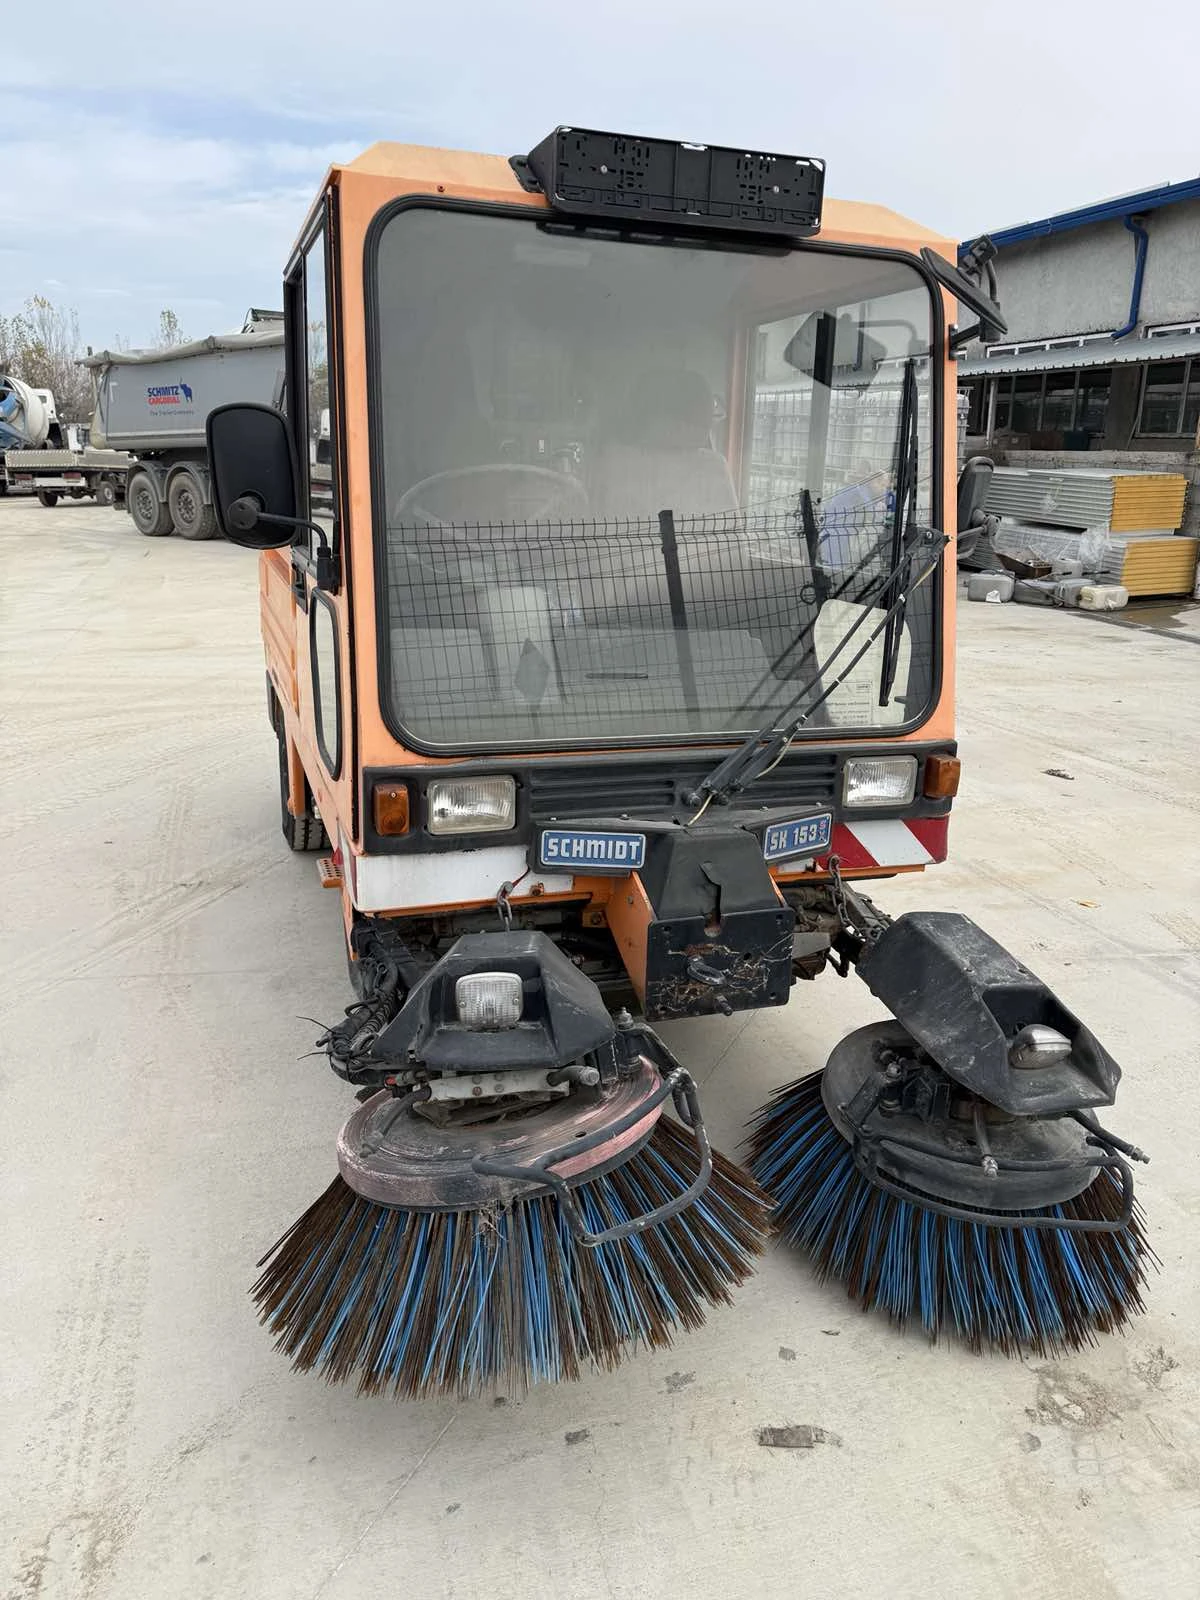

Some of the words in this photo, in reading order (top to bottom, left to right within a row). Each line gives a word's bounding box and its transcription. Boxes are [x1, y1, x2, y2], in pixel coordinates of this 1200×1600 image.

[147, 385, 180, 397] SCHMITZ
[793, 824, 818, 846] 153
[547, 838, 641, 861] SCHMIDT
